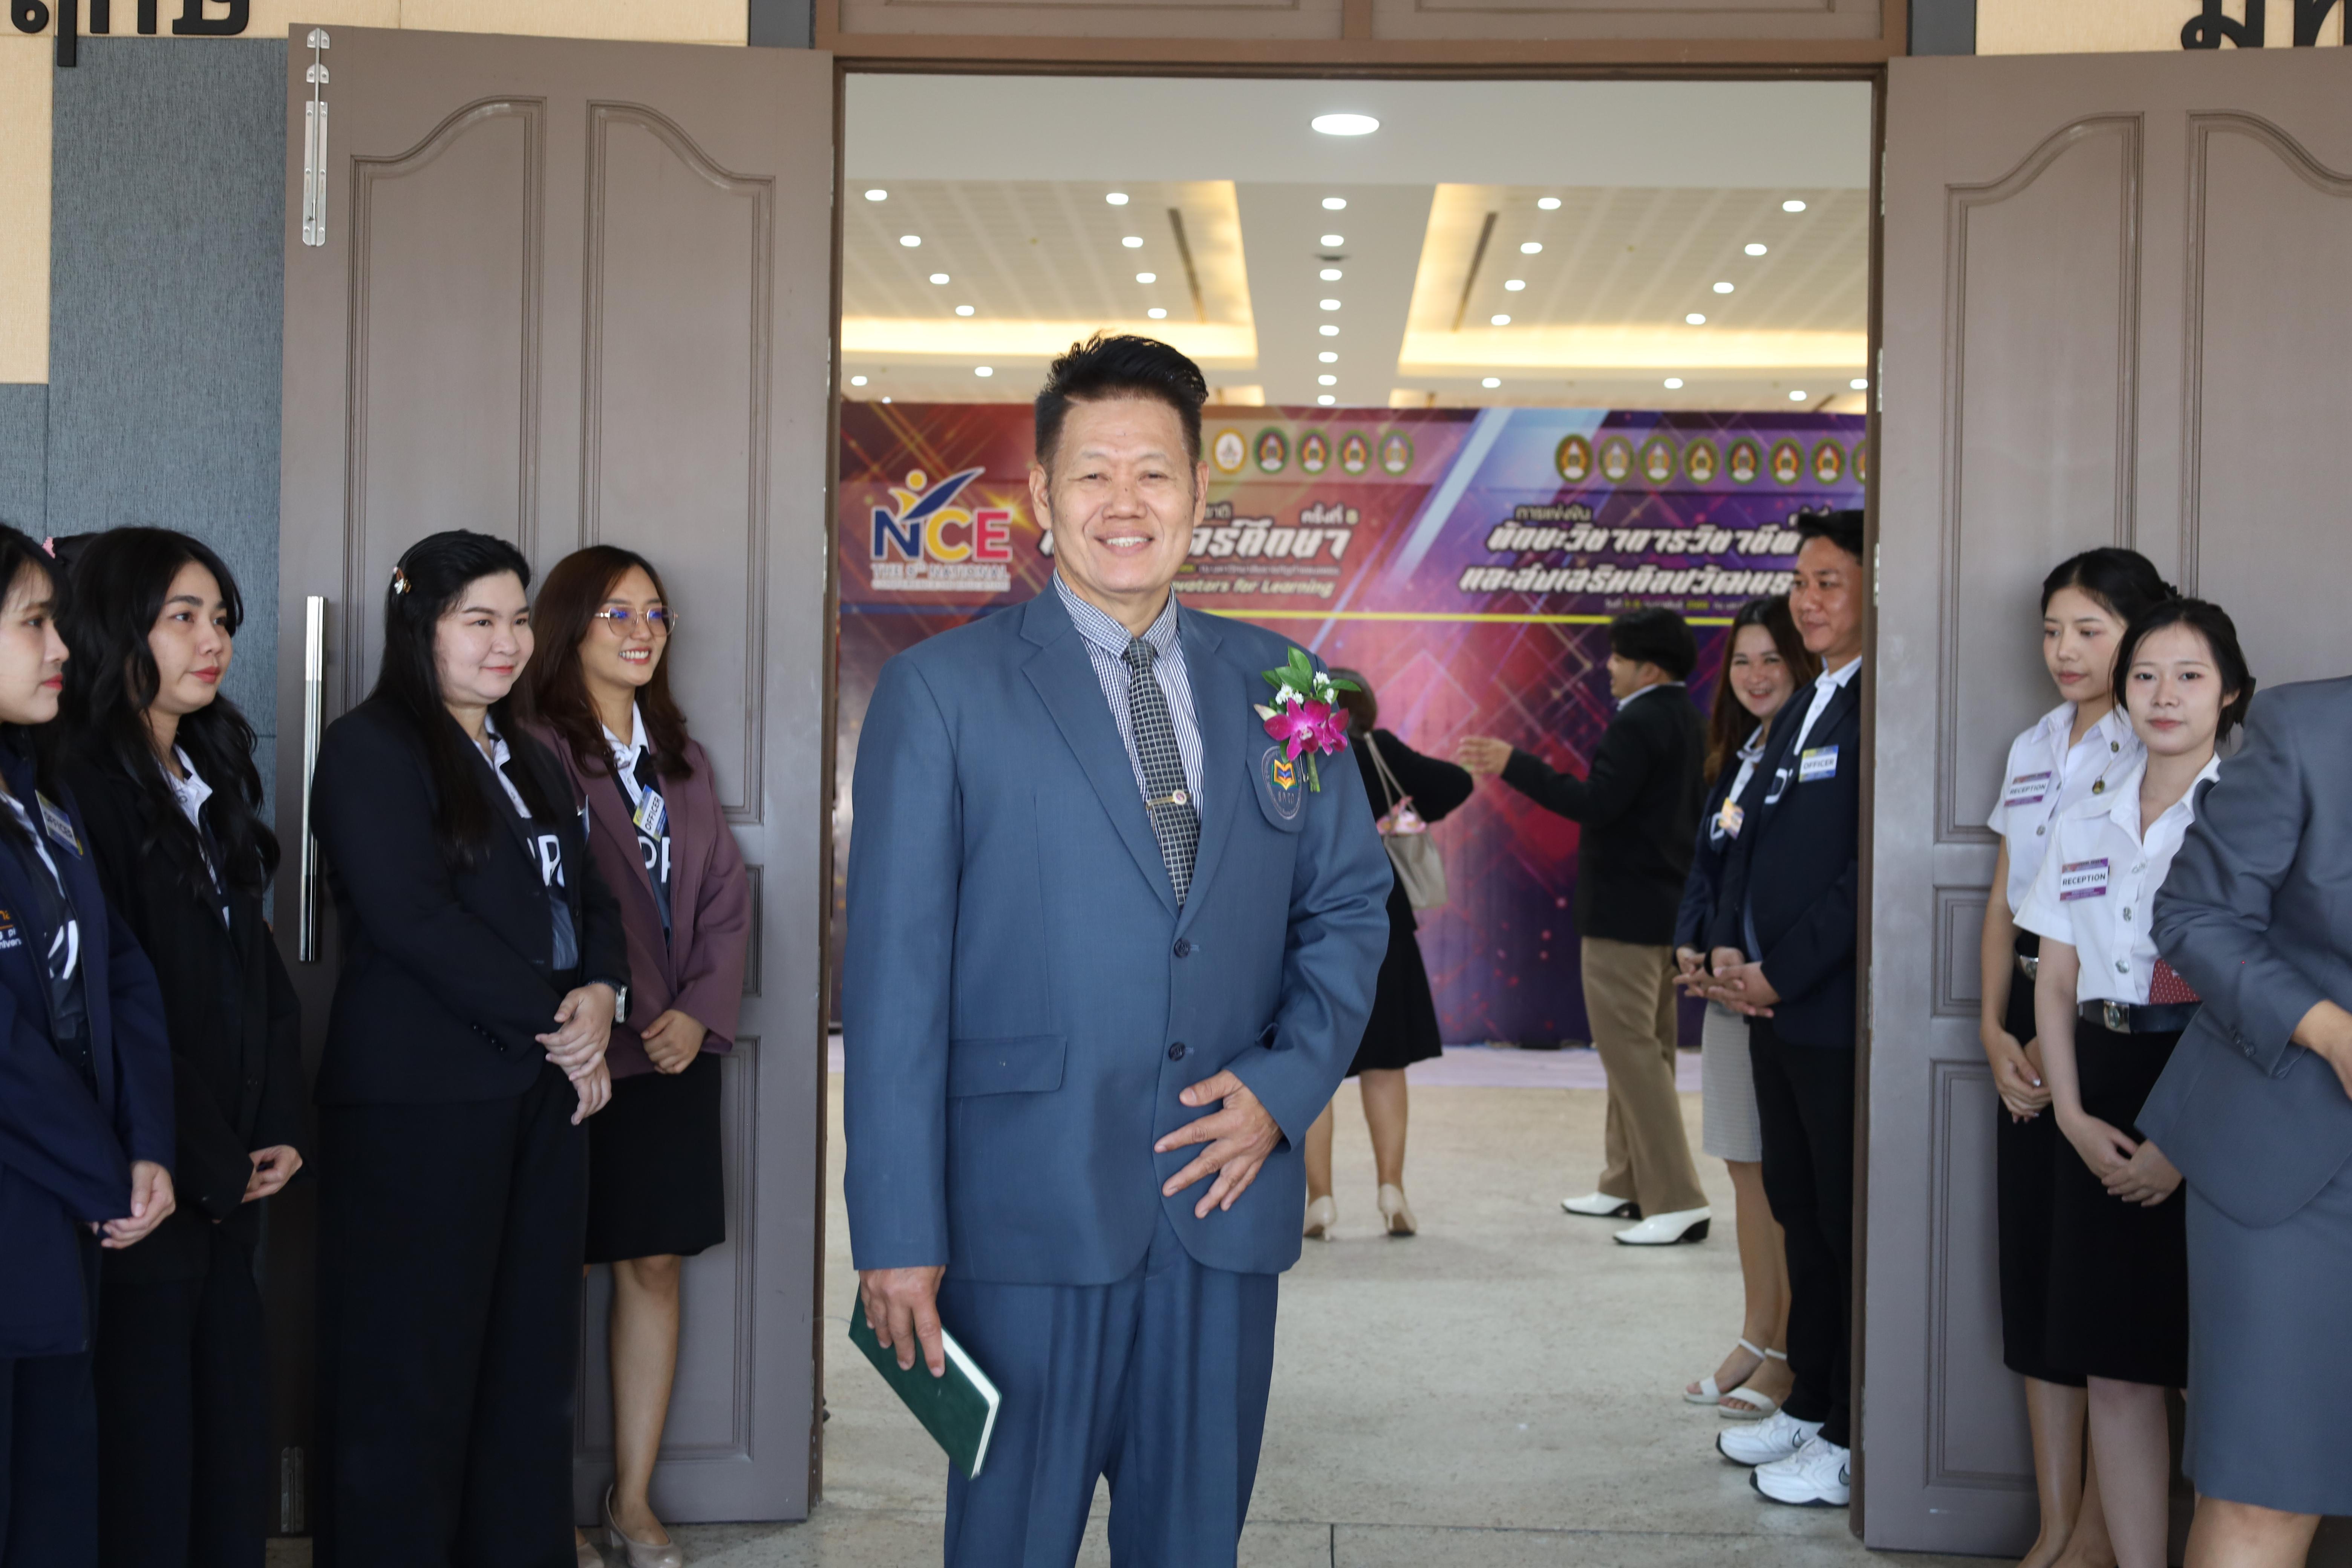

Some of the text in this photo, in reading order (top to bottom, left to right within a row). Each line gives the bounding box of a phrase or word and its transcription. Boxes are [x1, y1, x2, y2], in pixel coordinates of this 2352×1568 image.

[872, 507, 1011, 561] NCE
[1233, 577, 1259, 593] for
[1260, 578, 1336, 599] Learning
[1803, 758, 1834, 770] OFFICER
[2009, 783, 2046, 795] RECEPTION
[645, 796, 660, 830] OFFICER
[2063, 873, 2106, 886] RECEPTION
